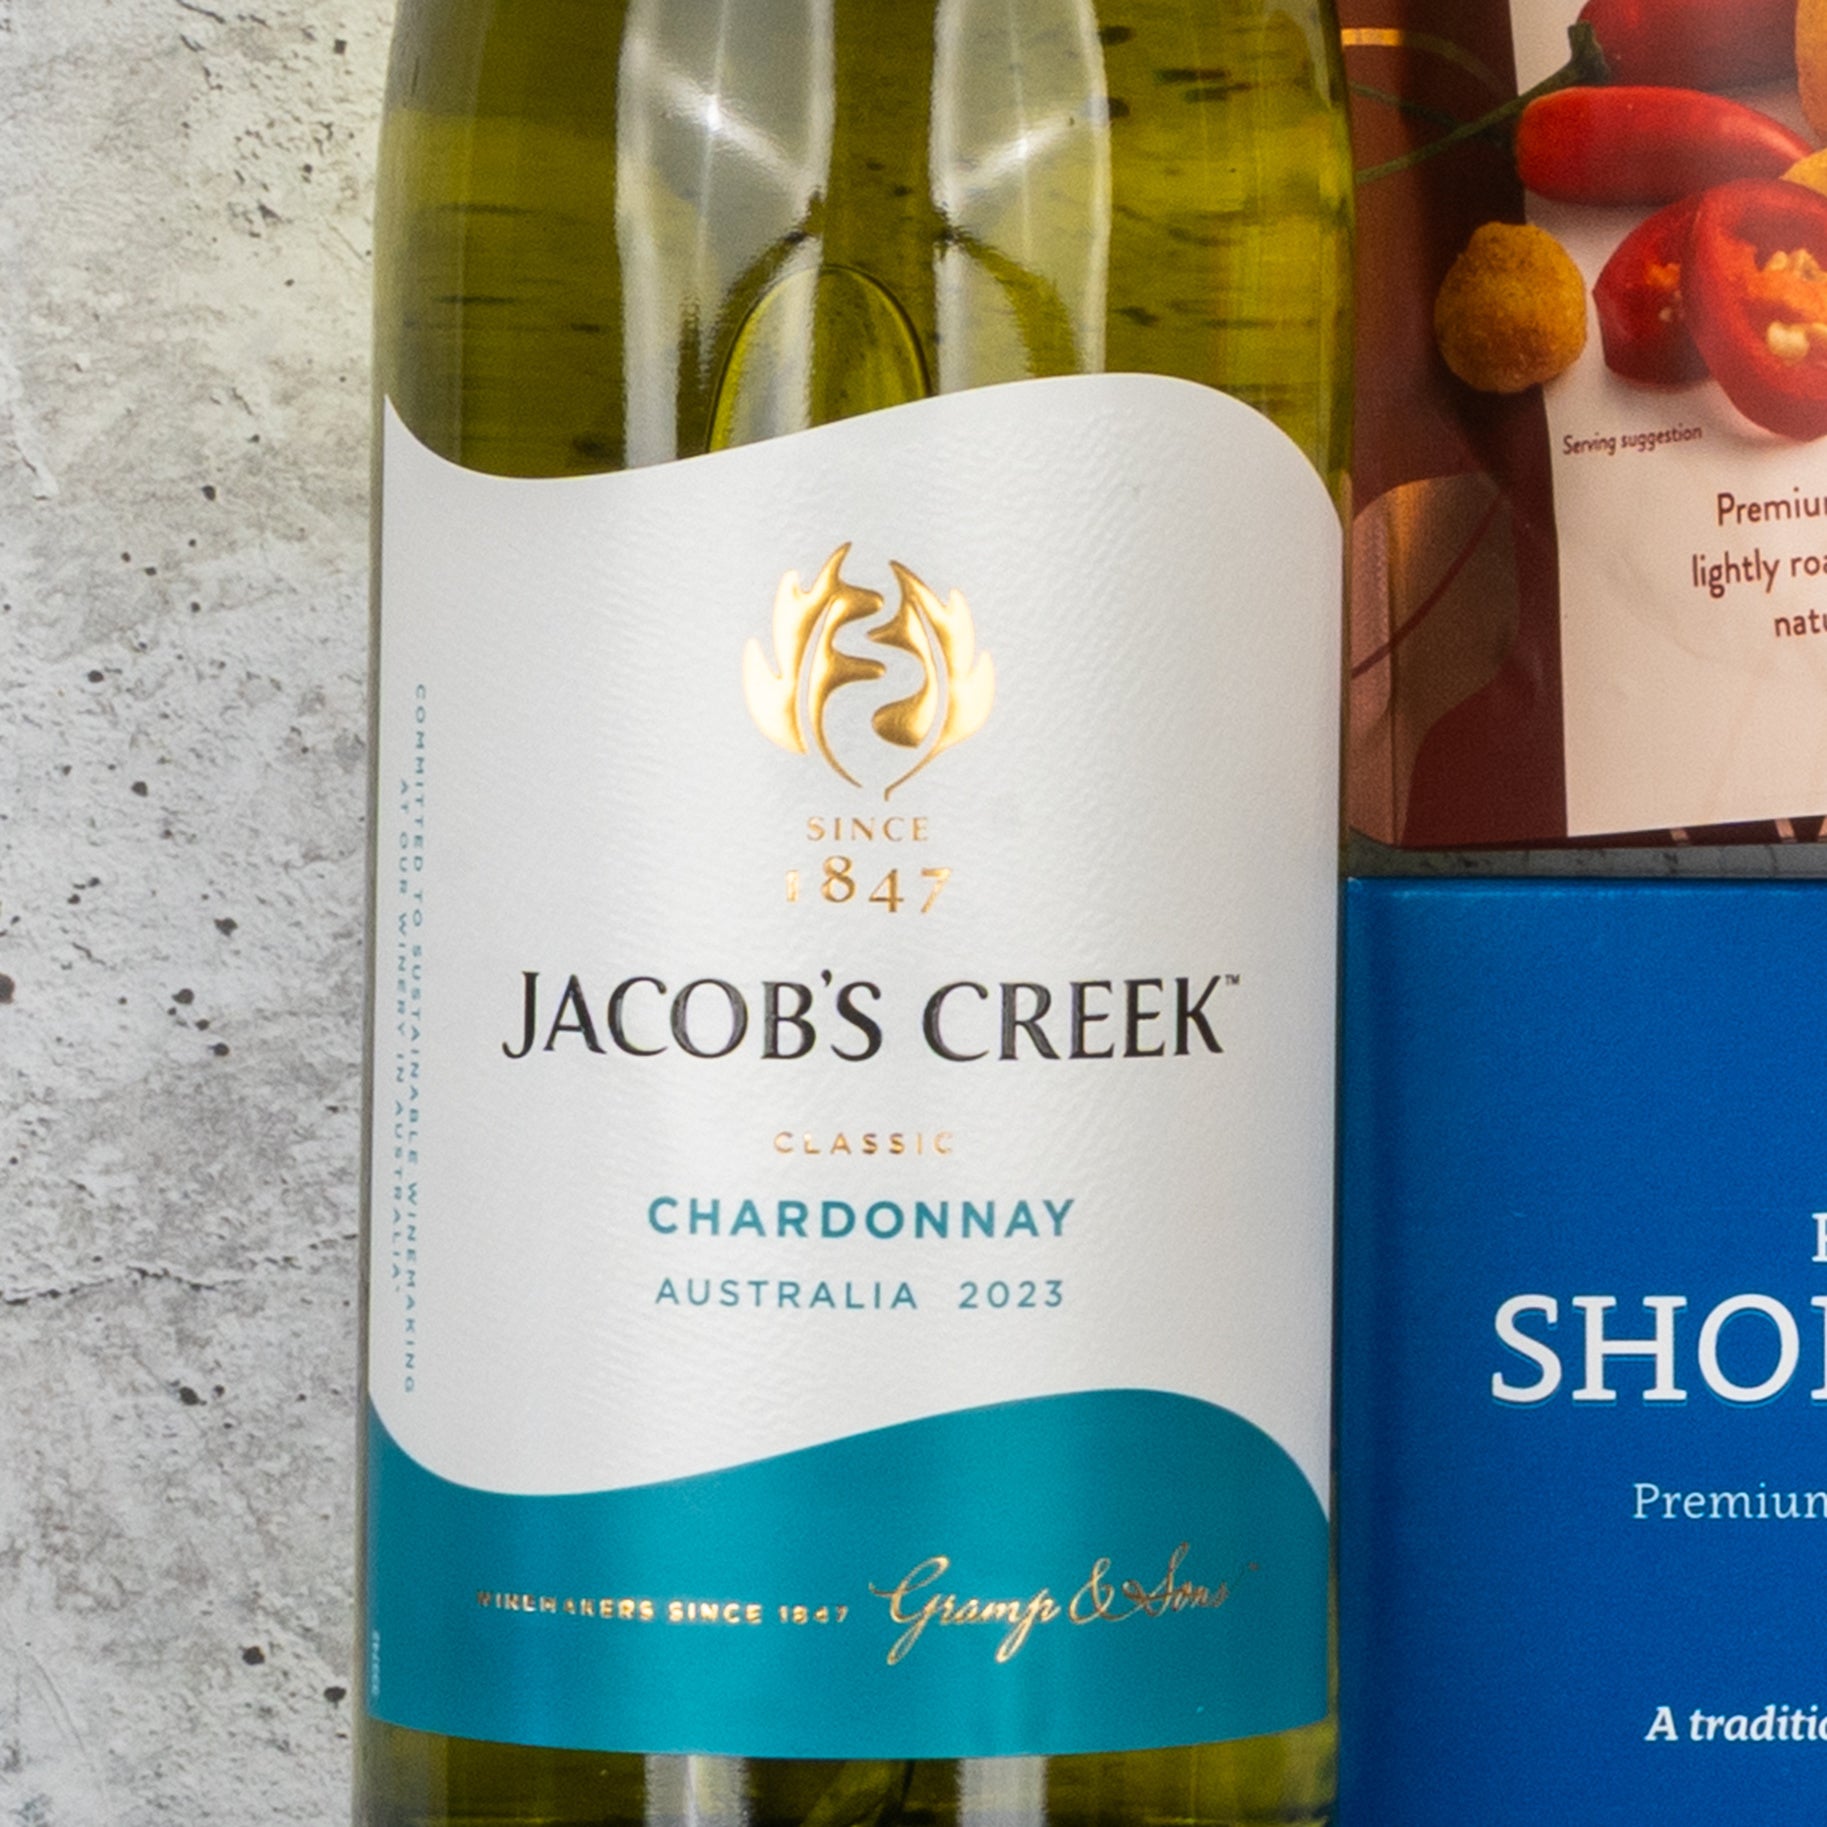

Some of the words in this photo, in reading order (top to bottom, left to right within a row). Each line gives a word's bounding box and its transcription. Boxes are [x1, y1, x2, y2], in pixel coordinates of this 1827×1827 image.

[1563, 432, 1616, 456] Serving
[1621, 423, 1703, 452] suggestion
[1717, 486, 1827, 526] Premiu
[1692, 548, 1780, 599] lightly
[1774, 609, 1827, 637] nat
[401, 780, 409, 813] AT
[414, 684, 426, 872] COMMITTED
[807, 816, 930, 842] SINCE
[399, 832, 409, 894] OUR
[785, 856, 952, 914] 1847
[413, 890, 422, 927] TO
[398, 912, 407, 1036] WINERY
[502, 969, 884, 1062] JACOB'S
[396, 1053, 404, 1082] IN
[408, 945, 422, 1164] SUSTAINABLE
[774, 1131, 955, 1156] CLASSIC
[648, 1196, 1074, 1240] CHARDONNAY
[405, 1182, 417, 1393] WINEMAKING
[655, 1277, 918, 1310] AUSTRALIA
[958, 1280, 1066, 1309] 2023
[1491, 1293, 1827, 1408] SHO
[668, 1600, 762, 1625] SINCE
[778, 1605, 849, 1624] 1847
[868, 1554, 1061, 1666] Gramp
[1121, 1542, 1230, 1618] Sons
[1644, 1706, 1679, 1741] A
